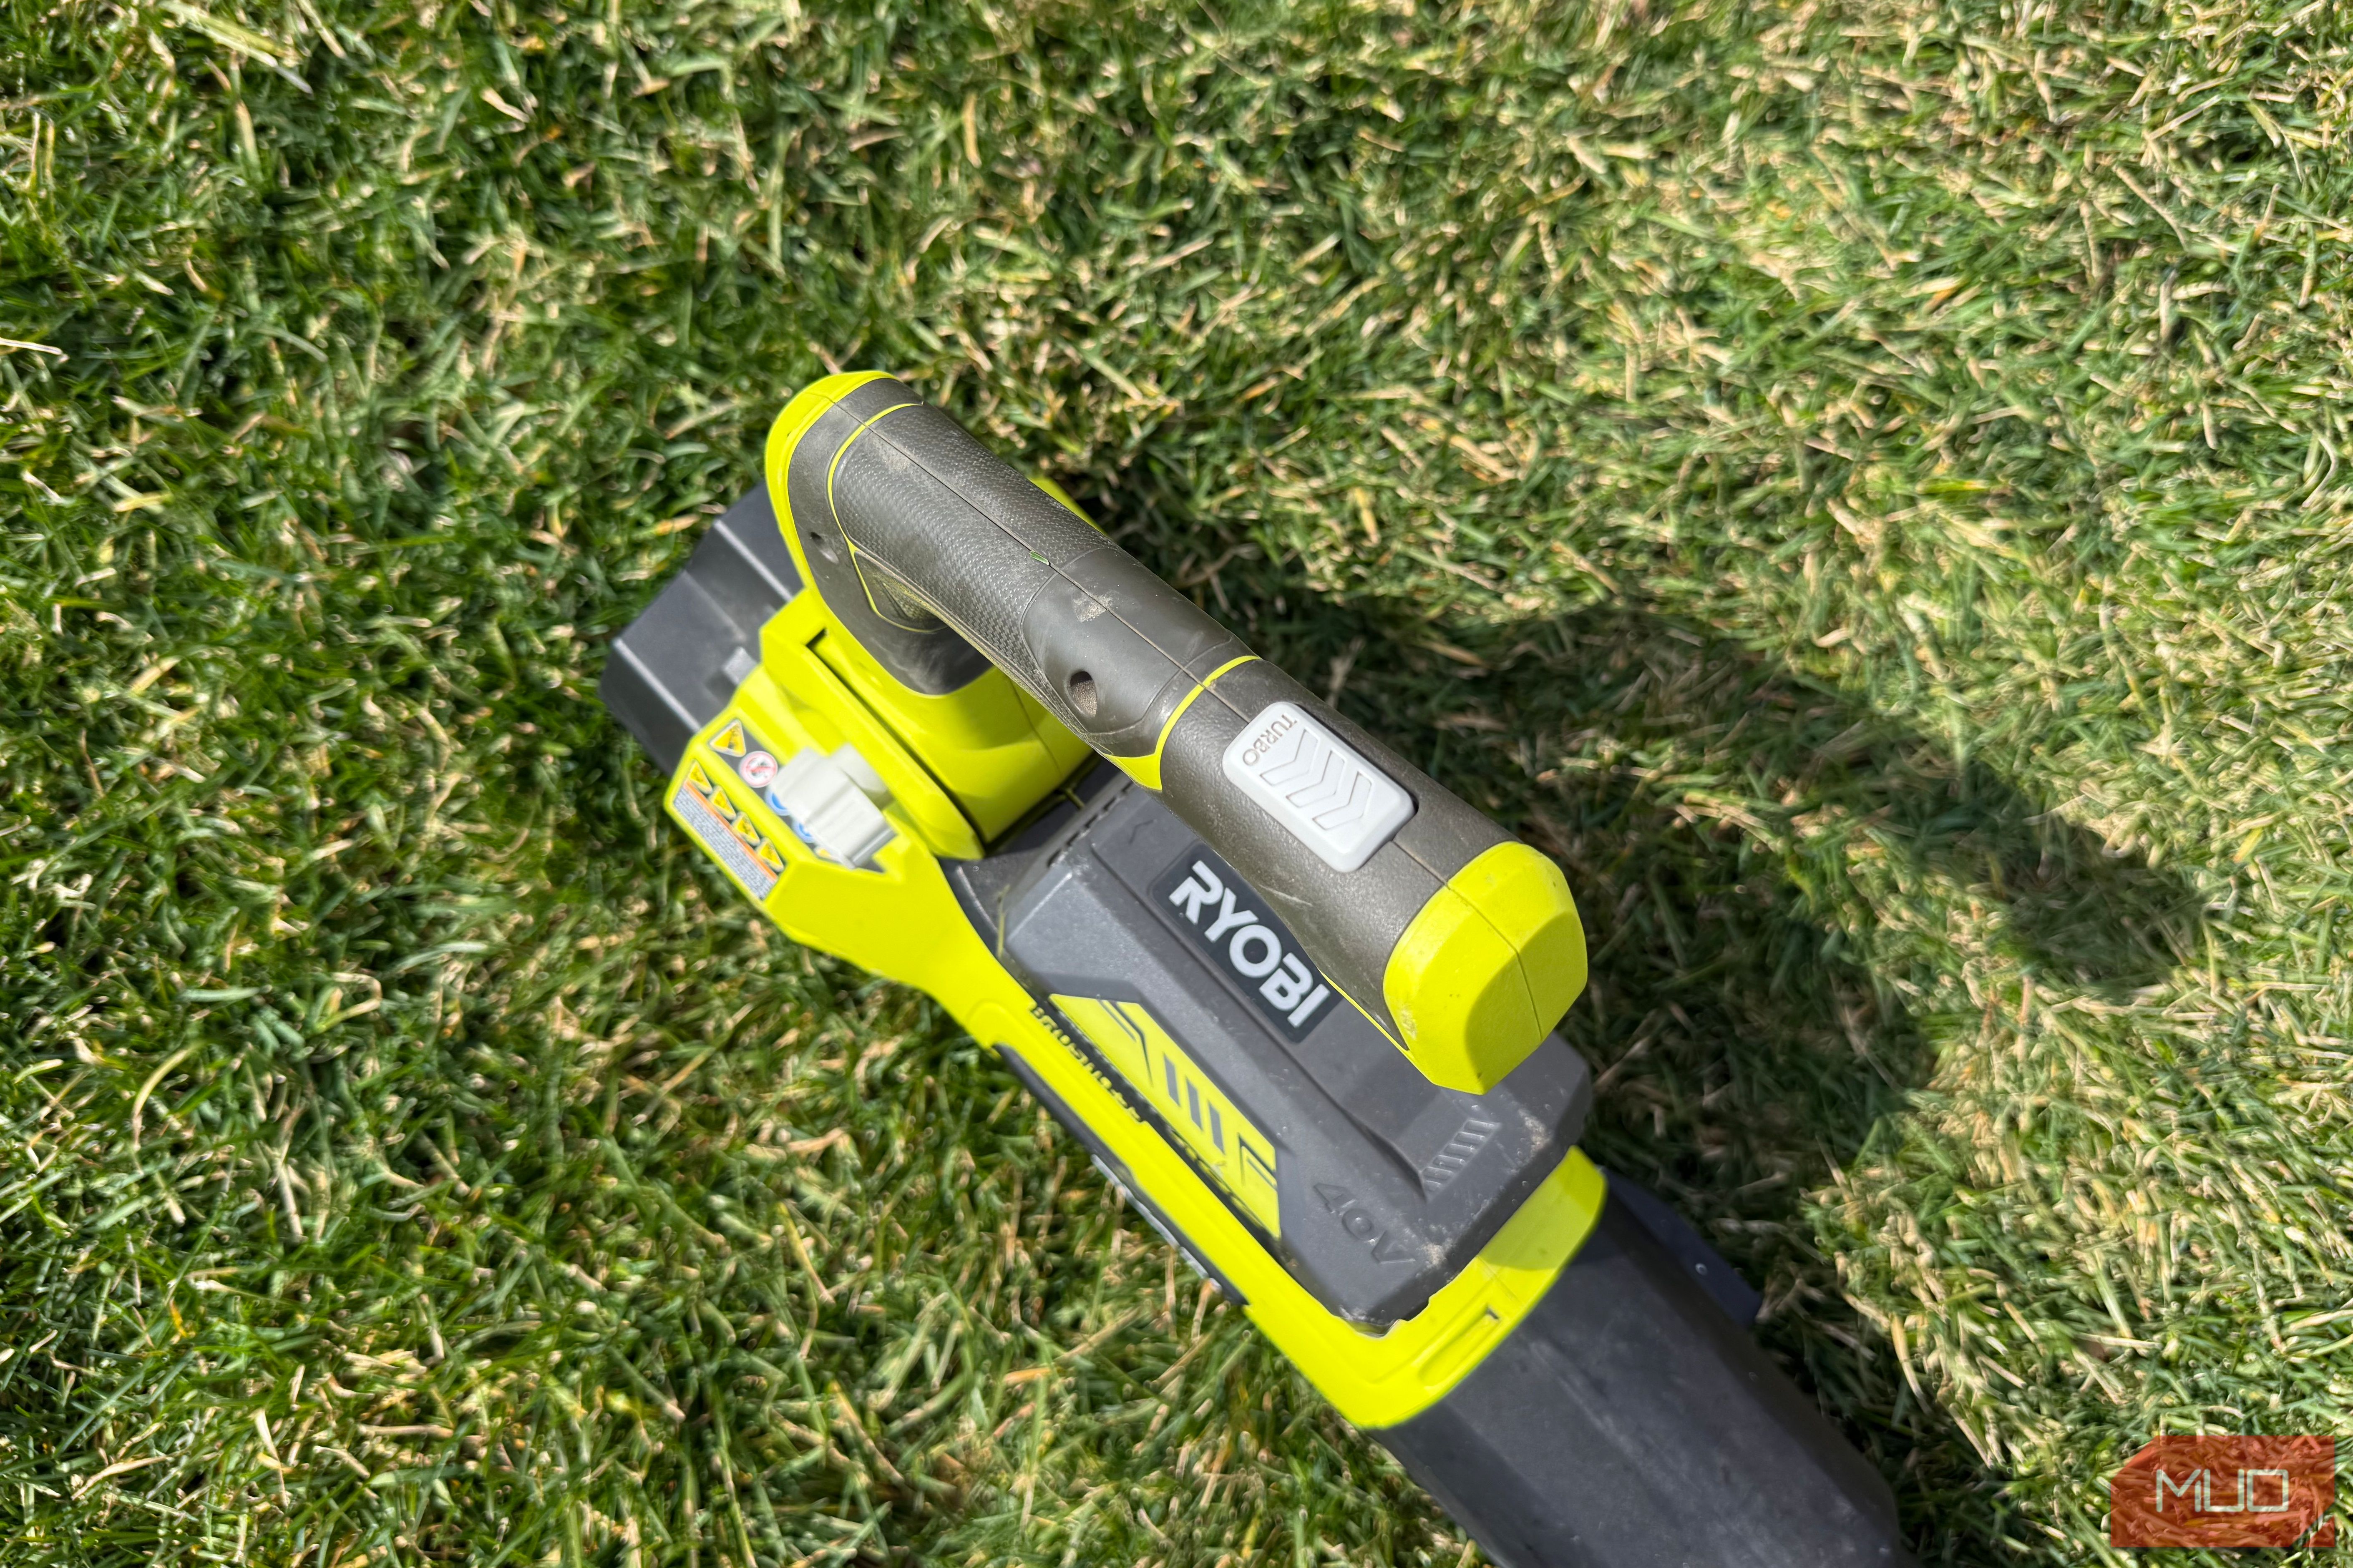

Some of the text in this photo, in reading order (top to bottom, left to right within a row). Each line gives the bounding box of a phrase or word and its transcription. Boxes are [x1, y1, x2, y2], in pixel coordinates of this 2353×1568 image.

[1243, 714, 1298, 766] TURBO
[1169, 860, 1330, 1028] RYOBI
[1313, 1182, 1416, 1264] 40V
